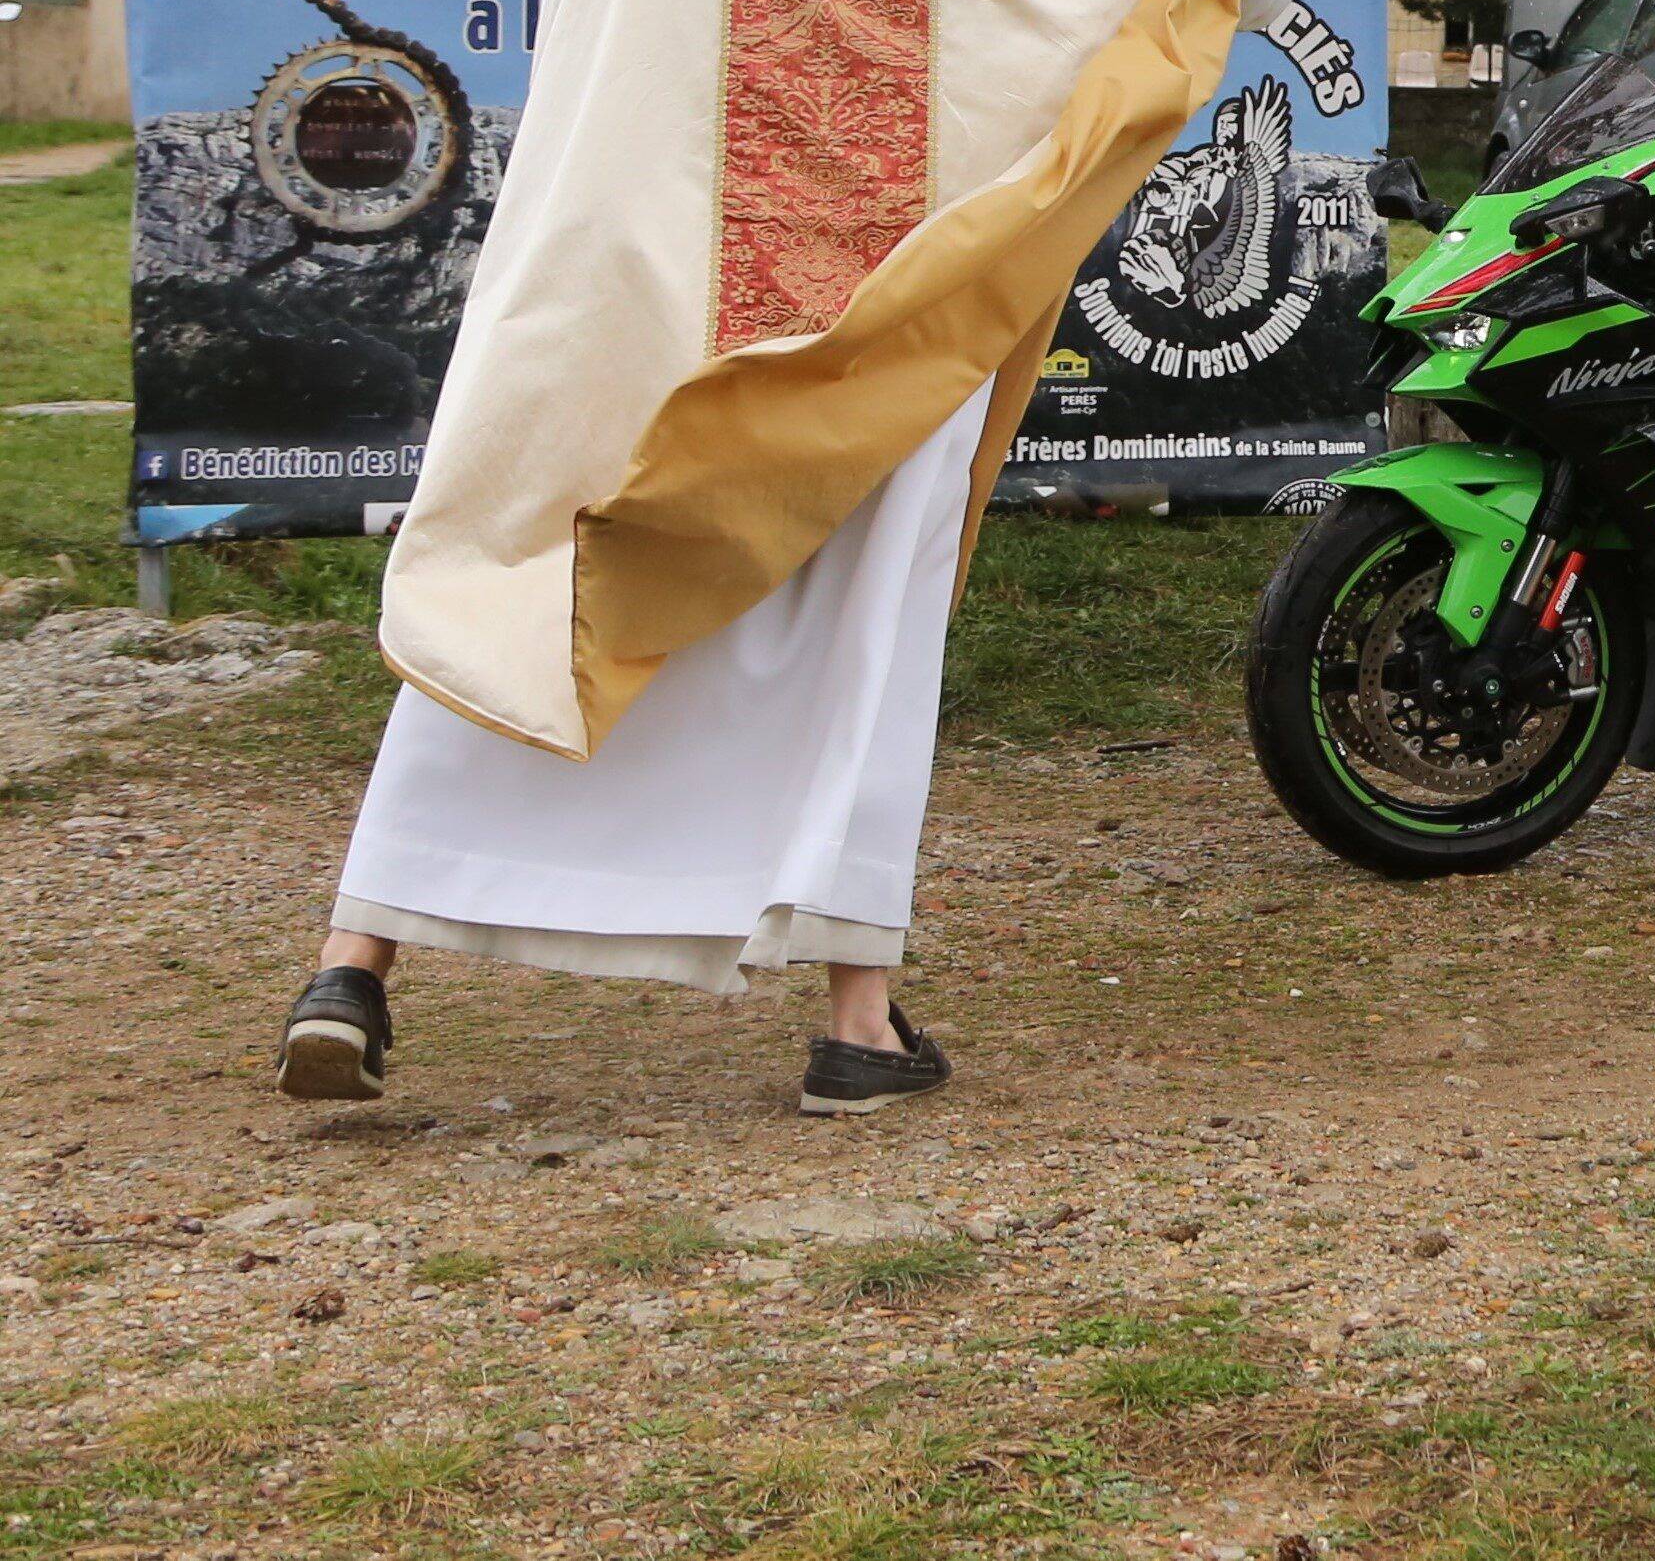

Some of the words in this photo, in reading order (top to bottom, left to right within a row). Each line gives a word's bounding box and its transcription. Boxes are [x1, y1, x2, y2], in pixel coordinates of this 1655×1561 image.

[1297, 196, 1349, 226] 2011
[1074, 277, 1152, 365] Souviens
[1150, 338, 1184, 378] toi
[1186, 341, 1250, 379] reste
[1016, 436, 1087, 462] Frères
[1093, 432, 1232, 460] Dominicains
[1235, 440, 1252, 456] de
[1256, 440, 1269, 456] la
[1272, 439, 1316, 456] Sainte
[1319, 439, 1366, 455] Baume
[181, 447, 343, 480] Bénédiction
[347, 446, 397, 477] des
[1284, 500, 1327, 515] MOT
